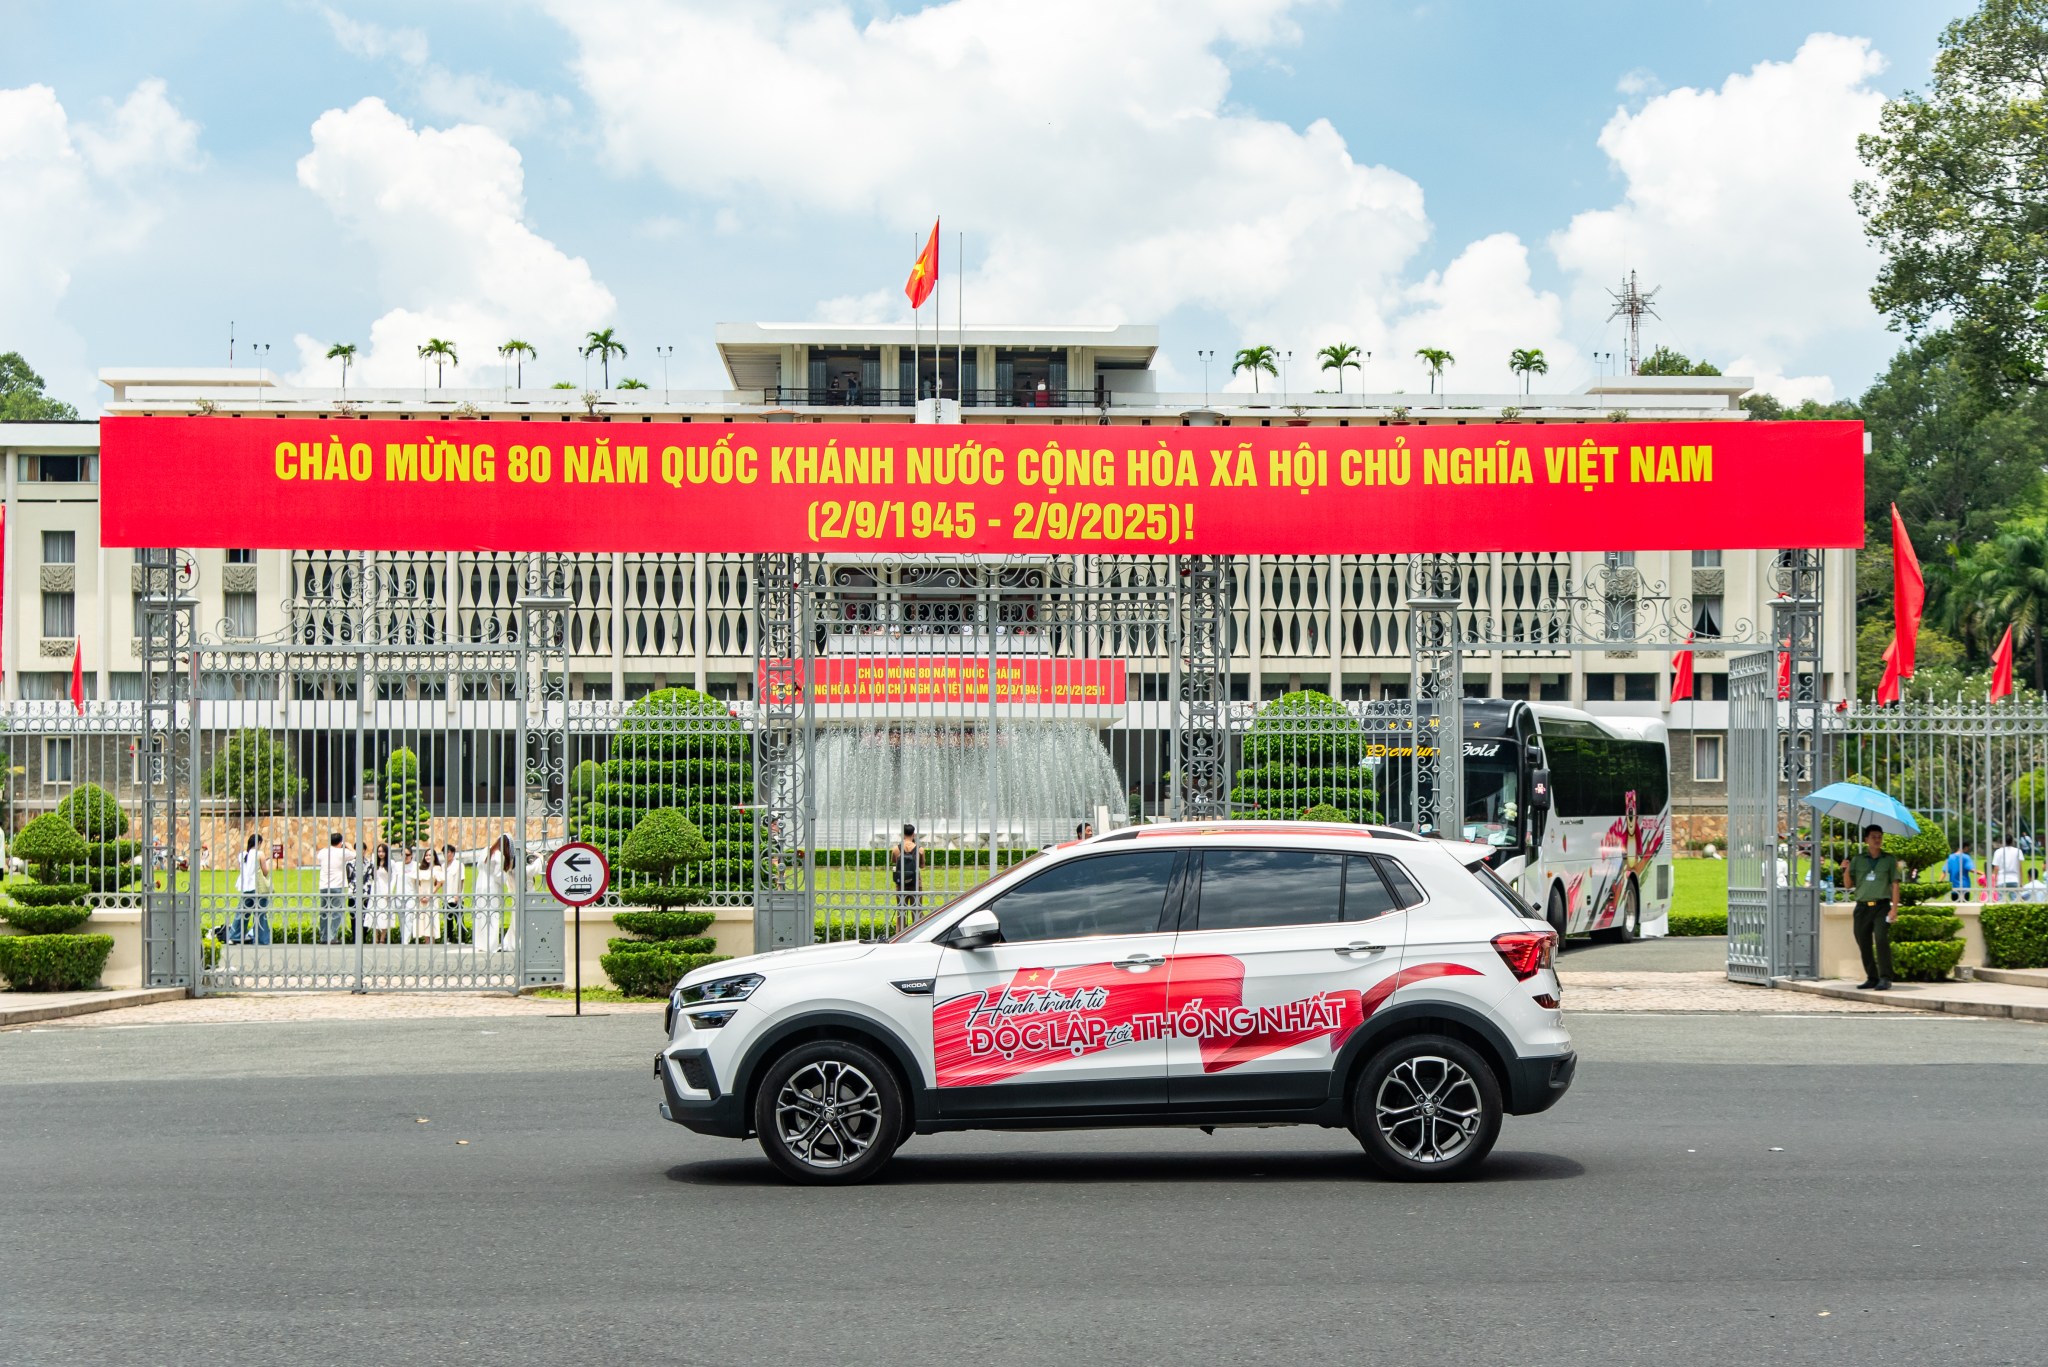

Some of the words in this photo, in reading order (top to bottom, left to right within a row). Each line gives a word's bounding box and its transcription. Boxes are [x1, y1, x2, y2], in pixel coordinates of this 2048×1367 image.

[275, 434, 373, 482] CHÀO
[385, 435, 495, 483] MỪNG
[507, 444, 551, 483] 80
[564, 437, 648, 484] NĂM
[661, 432, 758, 489] QUỐC
[771, 438, 894, 485] KHÁNH
[906, 439, 1005, 486] NƯỚC
[1017, 440, 1115, 495] CỘNG
[1127, 440, 1199, 487] HÒA
[1209, 442, 1258, 487] XÃ
[1269, 441, 1328, 495] HỘI
[1340, 436, 1411, 487] CHỦ
[1423, 439, 1534, 485] NGHĨA
[1543, 438, 1619, 492] VIỆT
[1630, 445, 1713, 483] NAM
[807, 500, 976, 543] (2/9/1945
[987, 518, 1001, 527] -
[1013, 501, 1194, 545] 2/9/2025)!
[910, 683, 940, 695] NGHA
[919, 668, 931, 679] 80
[988, 667, 1021, 680] HÁNH
[965, 987, 1034, 1028] Hành
[1038, 991, 1083, 1013] trình
[968, 1018, 1045, 1060] ĐỘC
[1049, 1013, 1107, 1055] LẬP
[1105, 1024, 1134, 1046] tới
[1133, 999, 1255, 1042] THỐNG
[1259, 992, 1347, 1035] NHẤT
